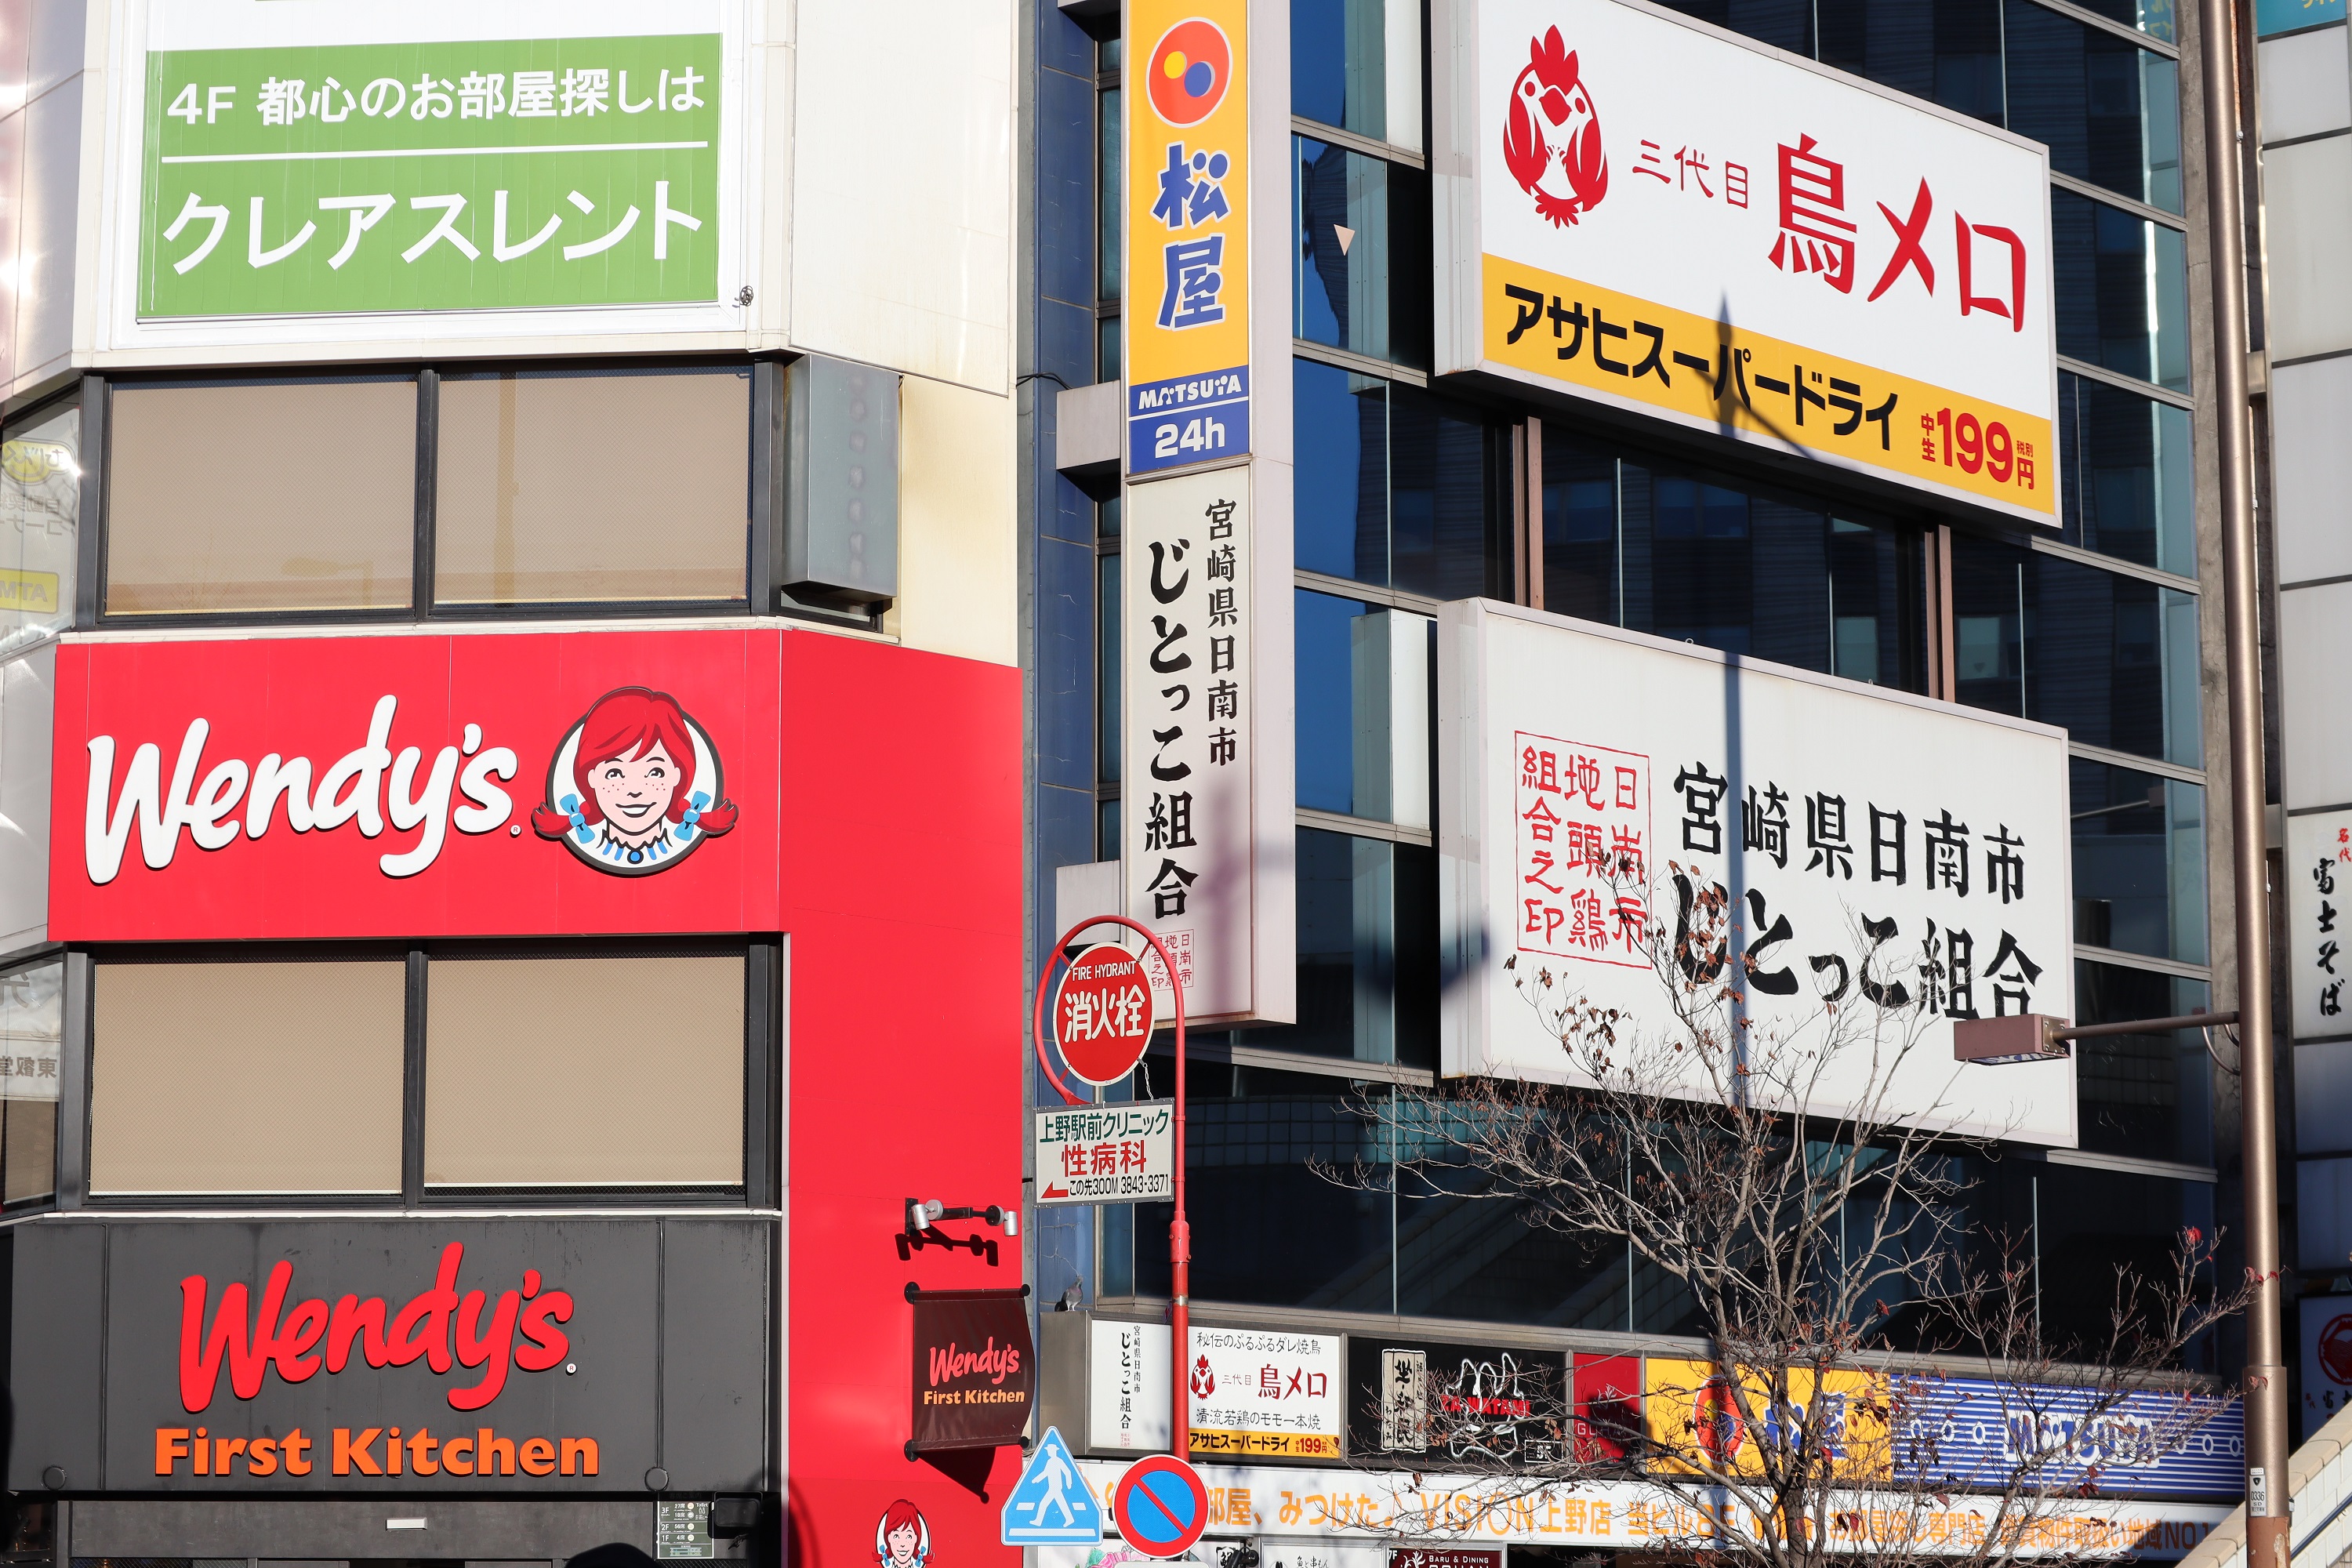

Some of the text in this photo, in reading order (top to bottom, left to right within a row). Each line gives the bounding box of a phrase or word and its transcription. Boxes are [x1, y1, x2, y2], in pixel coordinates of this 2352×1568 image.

[167, 65, 706, 127] 4F 都心のお部屋探しは
[162, 180, 702, 275] クレアスレント
[1149, 140, 1232, 332] 松屋
[1632, 132, 2027, 333] 三代目 鳥メロ
[1138, 374, 1243, 410] MATSUYA
[1504, 282, 1898, 452] アサヒスーパードライ
[1921, 413, 1936, 463] 中生
[1154, 416, 1225, 459] 24h
[2016, 440, 2034, 458] 税別
[1204, 499, 1239, 768] 宮崎県日南市
[1144, 538, 1200, 920] じとっこ組合
[85, 694, 518, 884] Wendy's
[1674, 760, 2026, 905] 宮崎県日南市
[1674, 872, 2043, 1020] じとっこ組合
[2313, 858, 2347, 1017] 富士そば
[1072, 960, 1138, 982] FIRE HYDRANT
[1064, 984, 1145, 1044] 消火栓
[1040, 1109, 1170, 1143] 上野駅前クリニック
[1061, 1139, 1147, 1178] 性病科
[1069, 1174, 1169, 1196] この先300M 3843-3371
[179, 1241, 575, 1413] Wendy's
[1196, 1331, 1321, 1356] 秘伝のぷるぷるダレ焼鳥
[929, 1336, 1020, 1387] Wendy's
[1120, 1332, 1132, 1429] じとっこ組合
[1221, 1363, 1327, 1401] 三代目 鳥メロ
[924, 1389, 1025, 1405] First Kitchen
[154, 1428, 601, 1477] First Kitchen
[1189, 1432, 1290, 1452] アサヒスーパードライ
[2251, 1491, 2264, 1501] 0336
